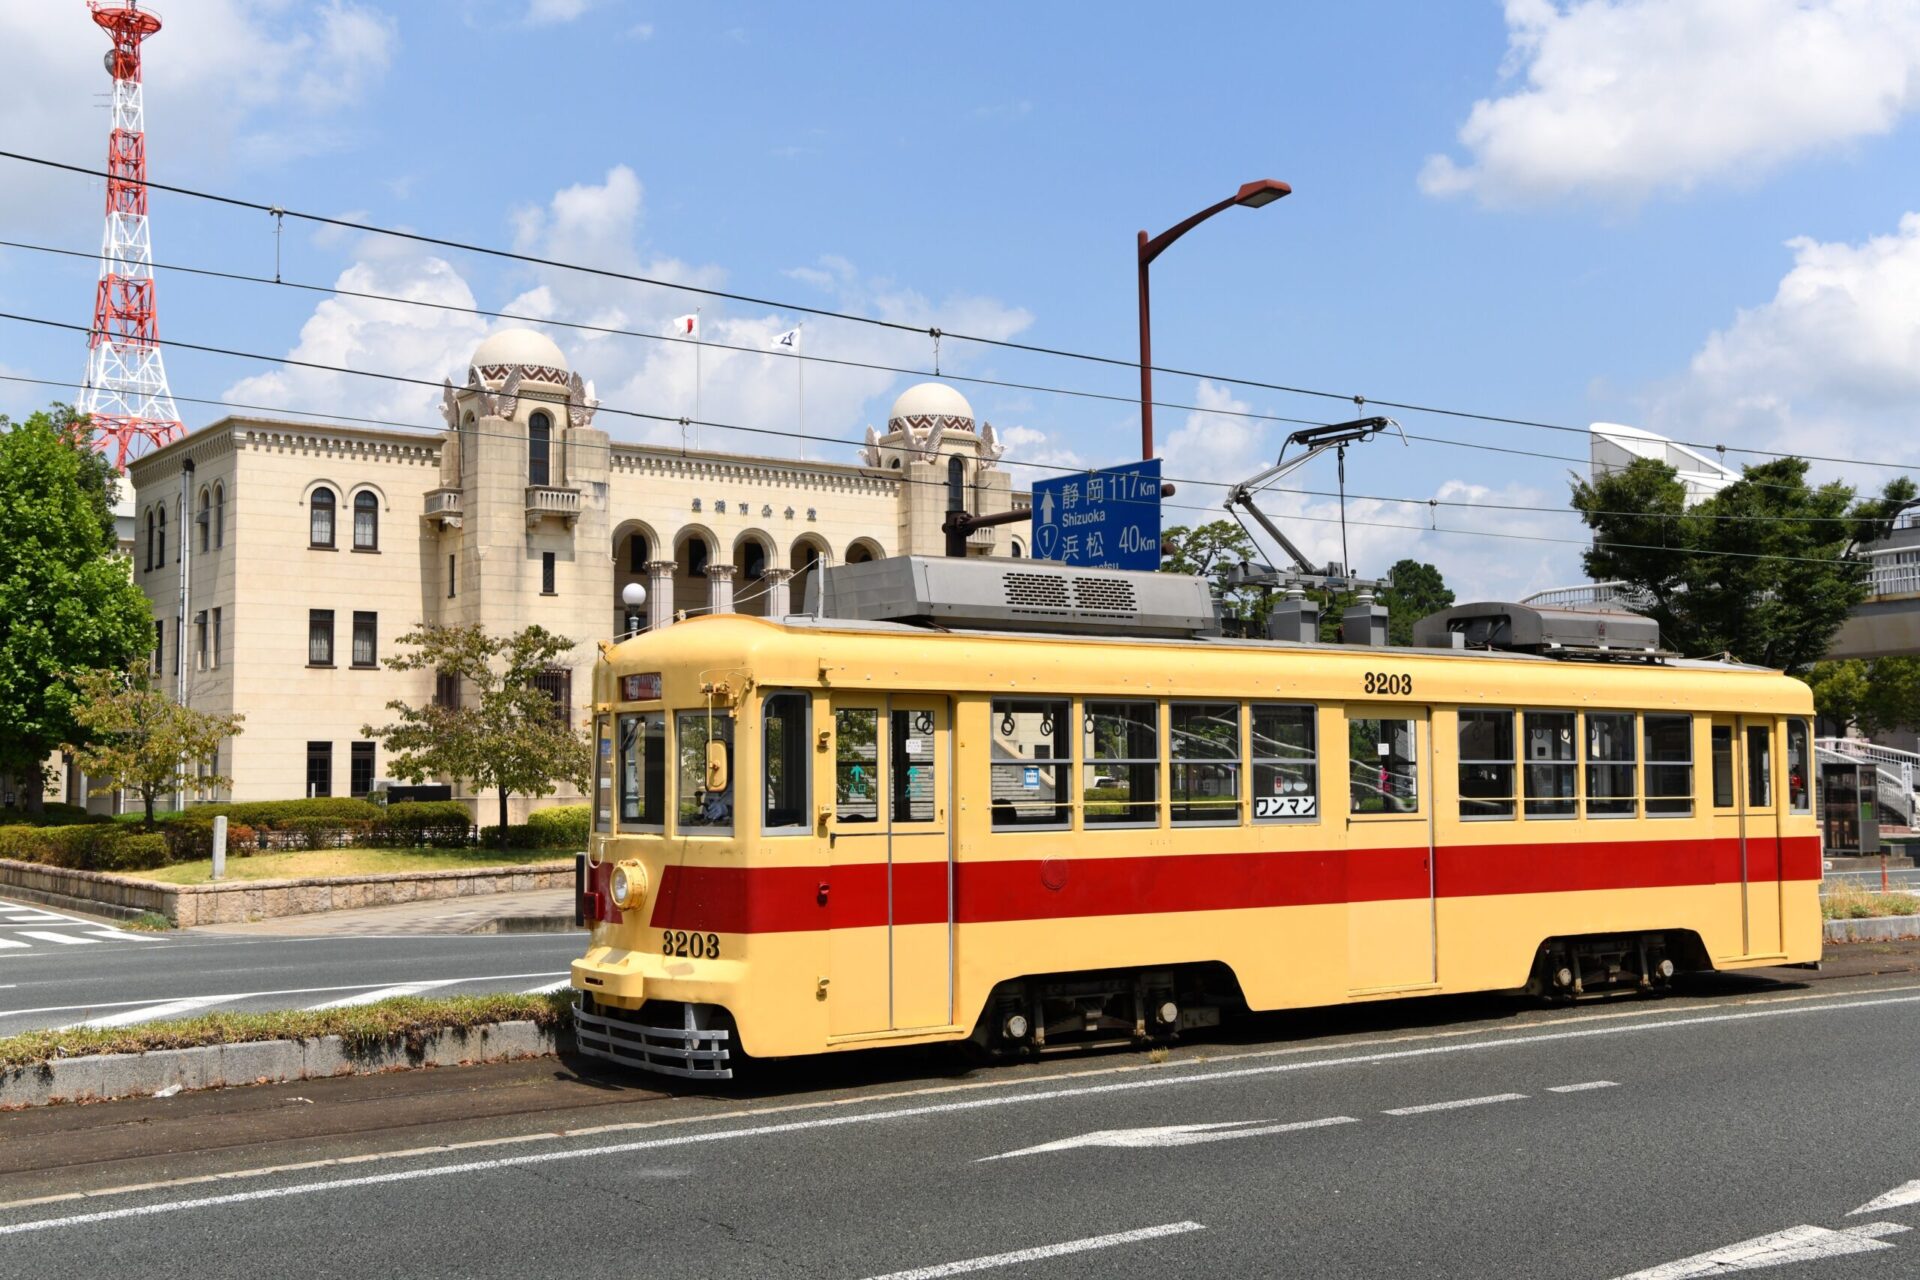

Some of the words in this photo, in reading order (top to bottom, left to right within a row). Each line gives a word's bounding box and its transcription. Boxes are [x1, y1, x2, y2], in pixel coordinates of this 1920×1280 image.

[1062, 477, 1104, 510] 静岡
[1062, 509, 1106, 528] Shizuoka
[1042, 529, 1049, 548] 1
[1061, 531, 1104, 561] 浜松
[1364, 671, 1412, 696] 3203
[1256, 797, 1315, 816] ワンマン
[662, 929, 720, 960] 3203
